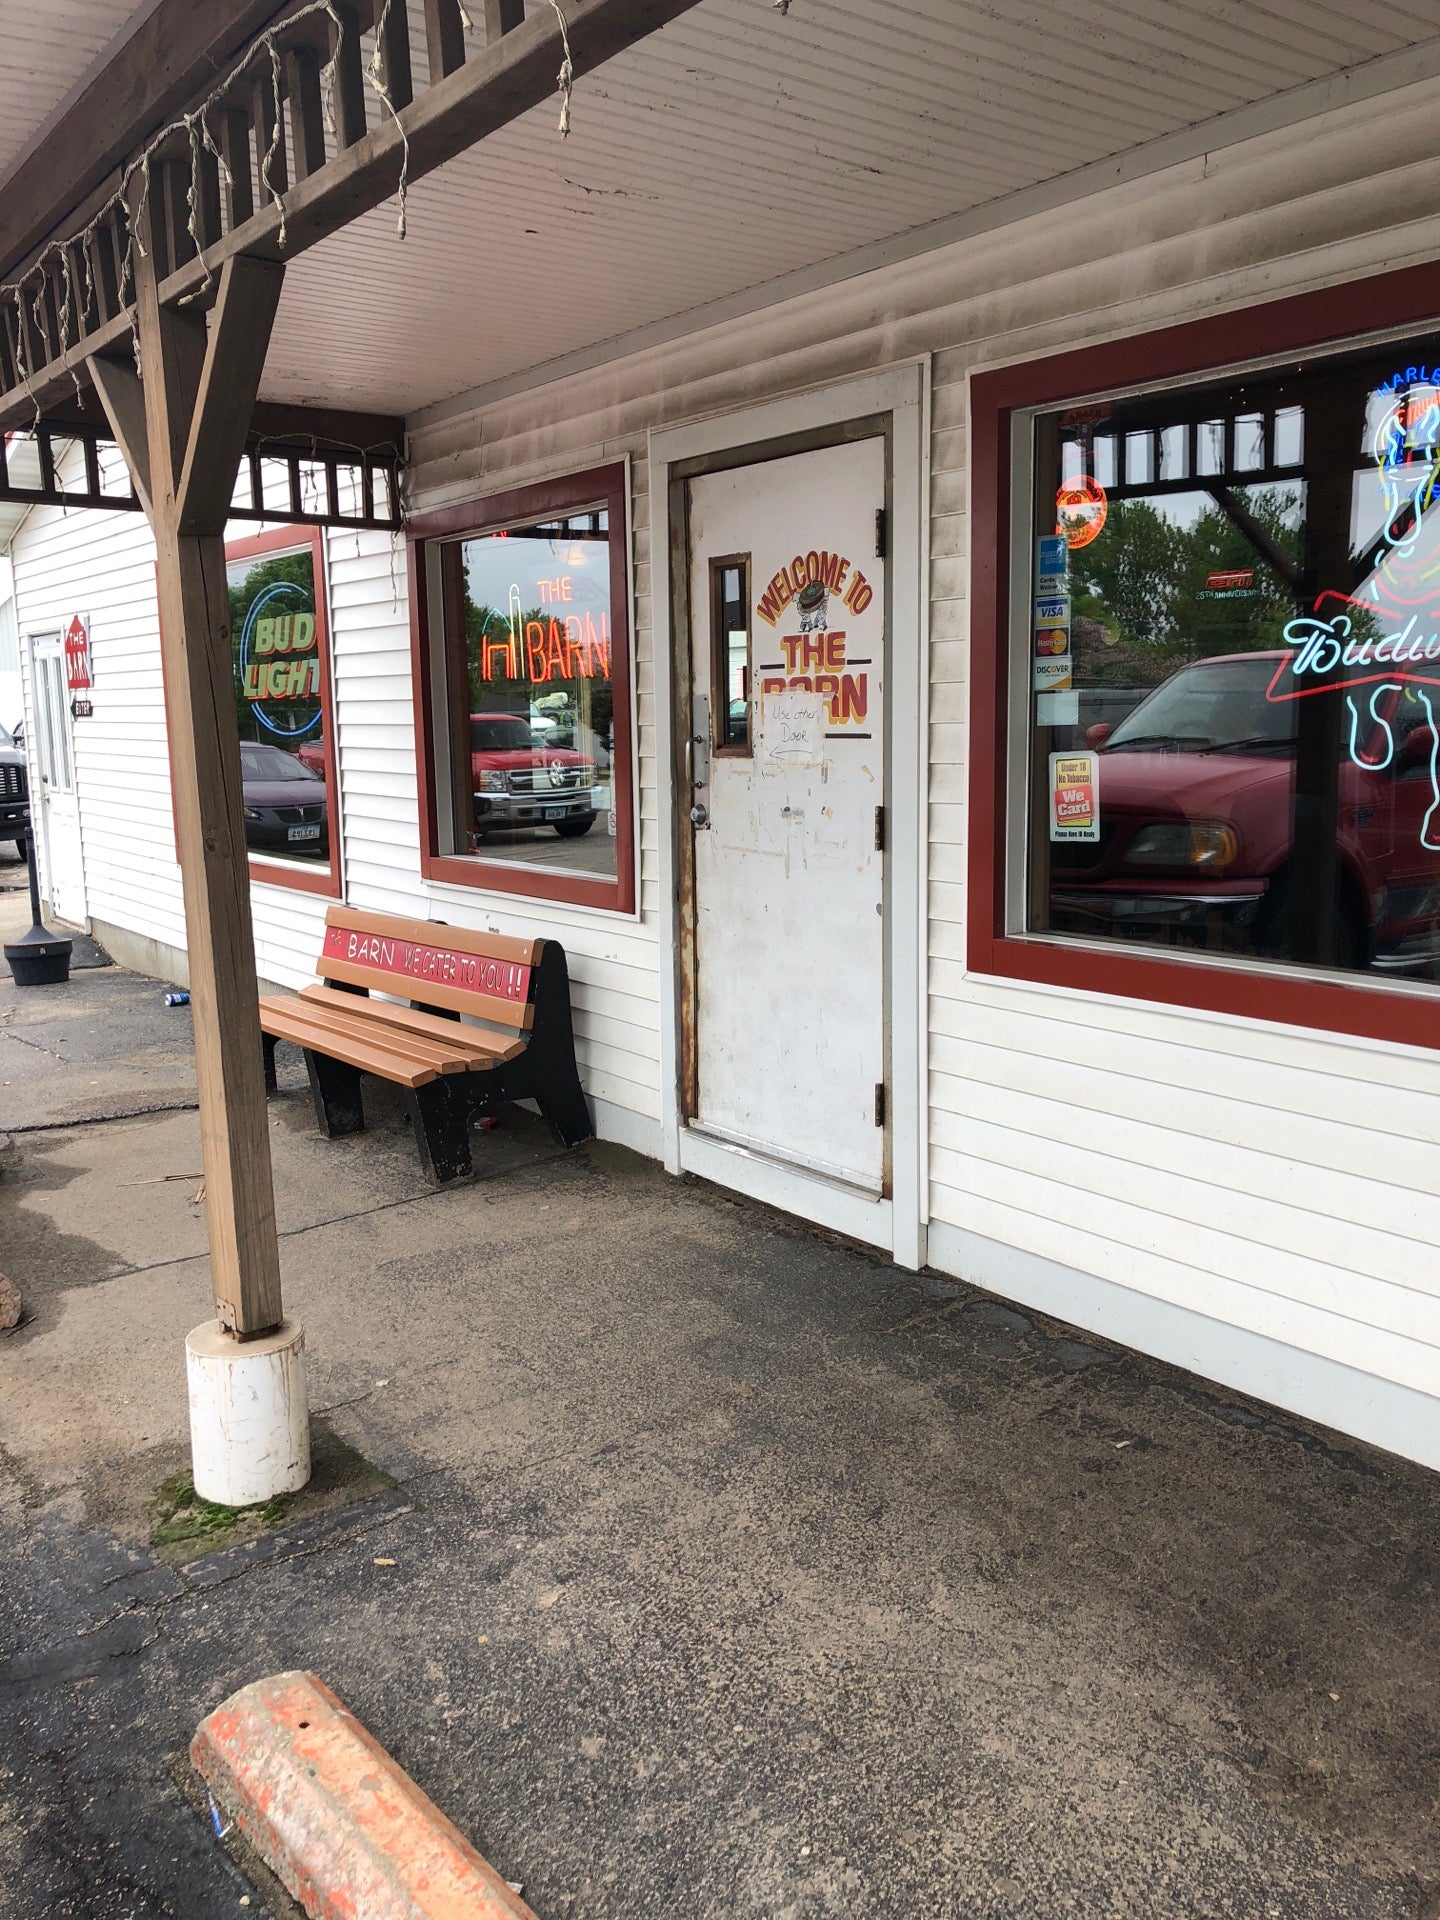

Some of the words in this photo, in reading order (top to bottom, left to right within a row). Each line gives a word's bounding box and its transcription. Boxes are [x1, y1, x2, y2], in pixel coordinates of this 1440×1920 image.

[537, 576, 572, 604] THE
[757, 550, 851, 628] WELCOME
[843, 570, 873, 616] TO
[1041, 606, 1064, 617] VISA
[69, 631, 85, 645] THE
[255, 612, 317, 655] BUD
[526, 611, 609, 683] BARN
[780, 631, 846, 675] THE
[1036, 665, 1069, 674] DISCOVER
[243, 659, 321, 700] LIGHT
[75, 702, 90, 715] ENTER
[772, 704, 790, 720] Use
[794, 709, 818, 720] other
[1061, 763, 1077, 773] Under
[1080, 762, 1087, 771] 18
[1058, 774, 1066, 783] No
[1067, 774, 1089, 783] Tobacco
[1062, 790, 1085, 803] We
[1057, 801, 1091, 816] Card
[347, 933, 394, 967] BARN
[403, 945, 421, 973] WE
[422, 951, 456, 980] CATER
[461, 958, 476, 984] TO
